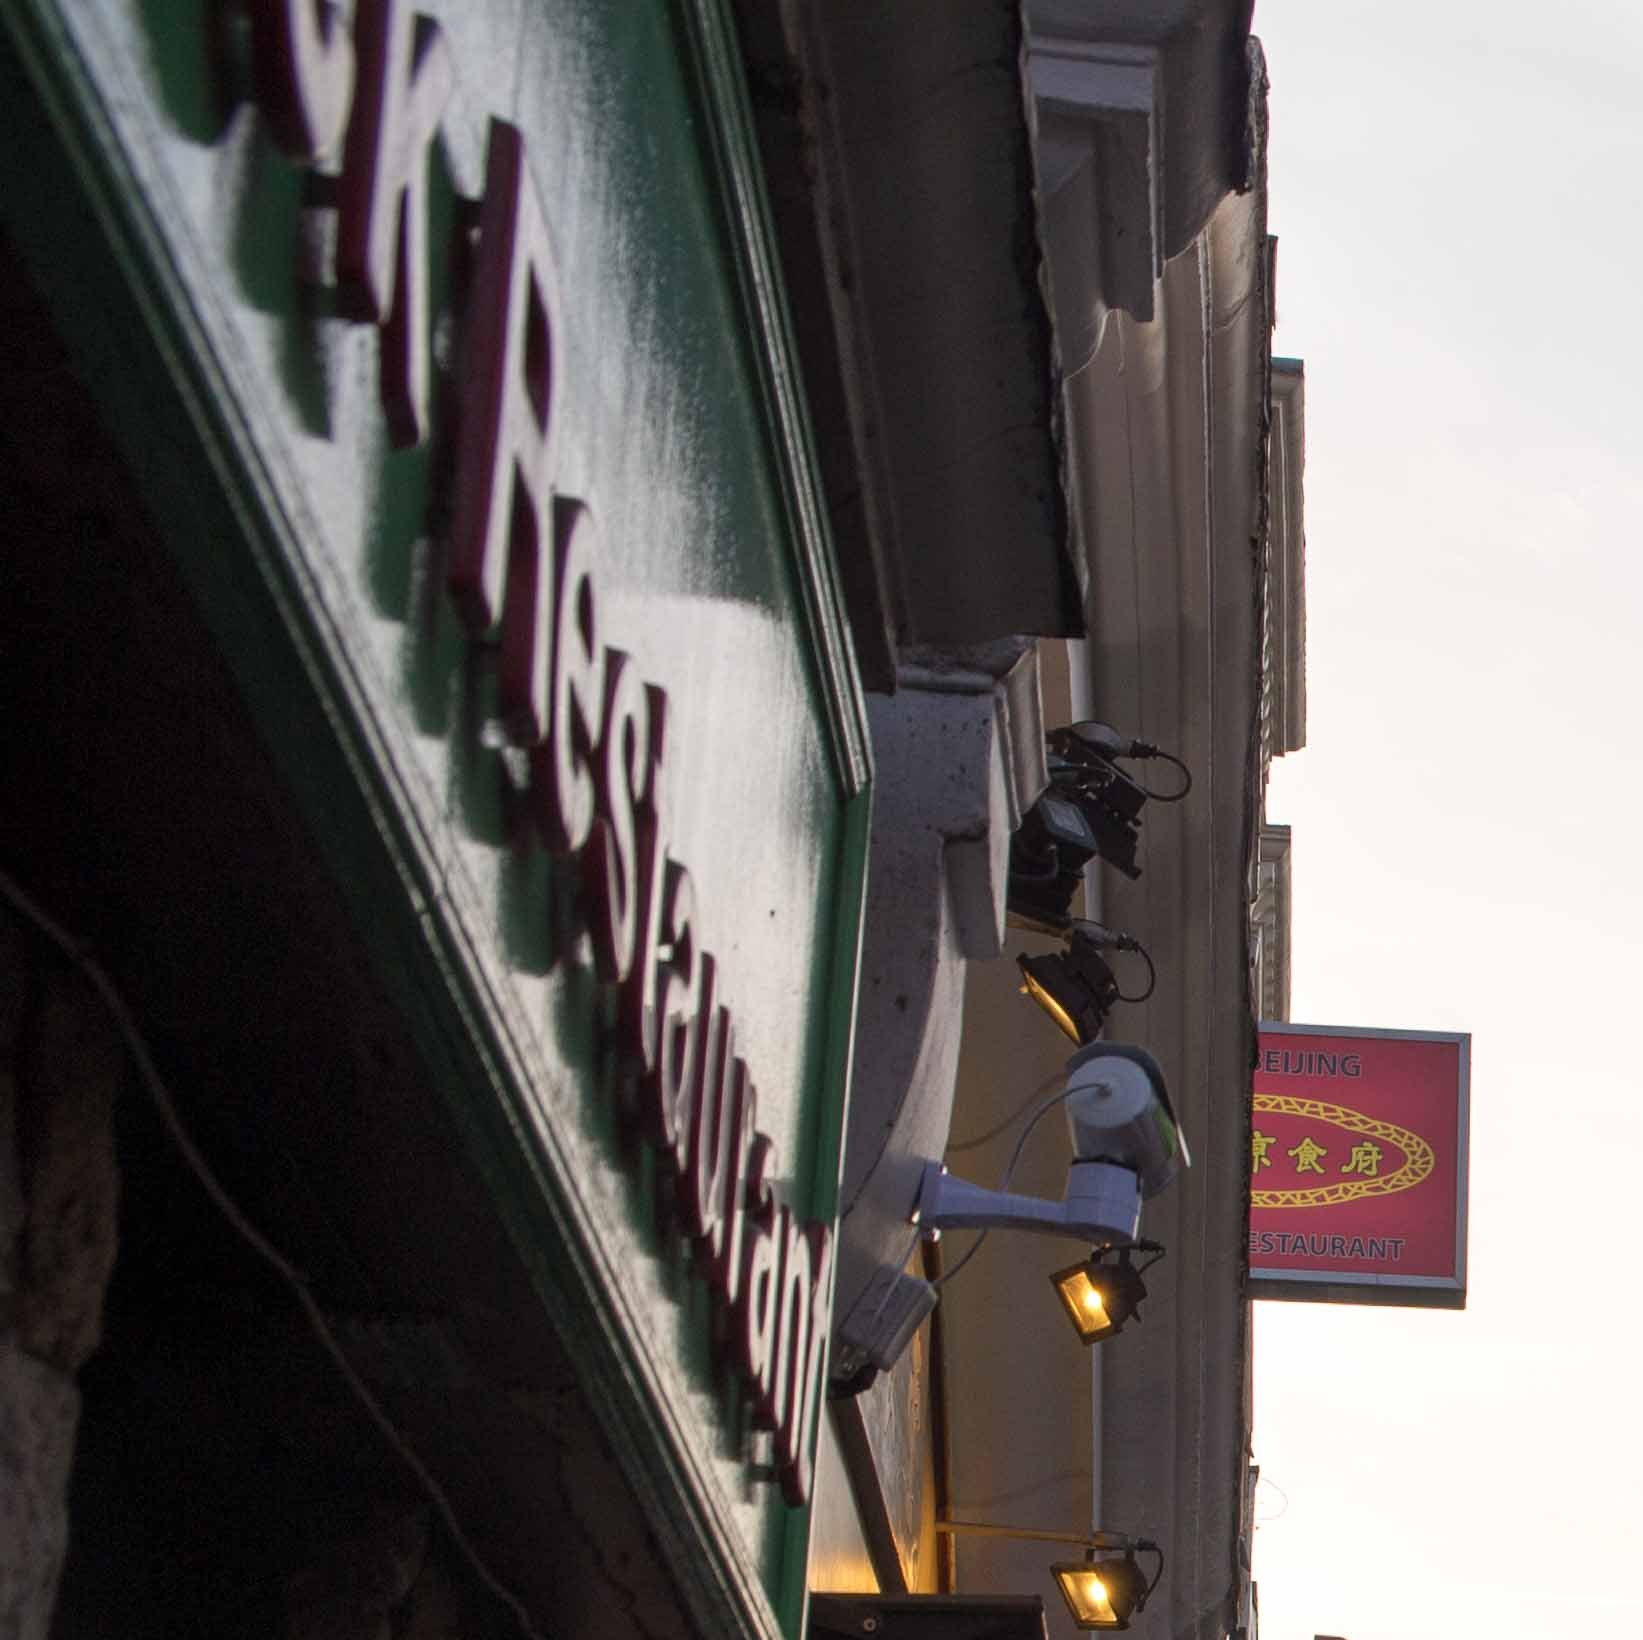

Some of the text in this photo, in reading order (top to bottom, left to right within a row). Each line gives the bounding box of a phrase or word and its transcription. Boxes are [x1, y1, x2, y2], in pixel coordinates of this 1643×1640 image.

[450, 116, 835, 1507] Restaurant
[1257, 1050, 1361, 1078] EIJING
[1251, 1131, 1383, 1177] 京食府
[1250, 1232, 1405, 1262] ESTAURANT
